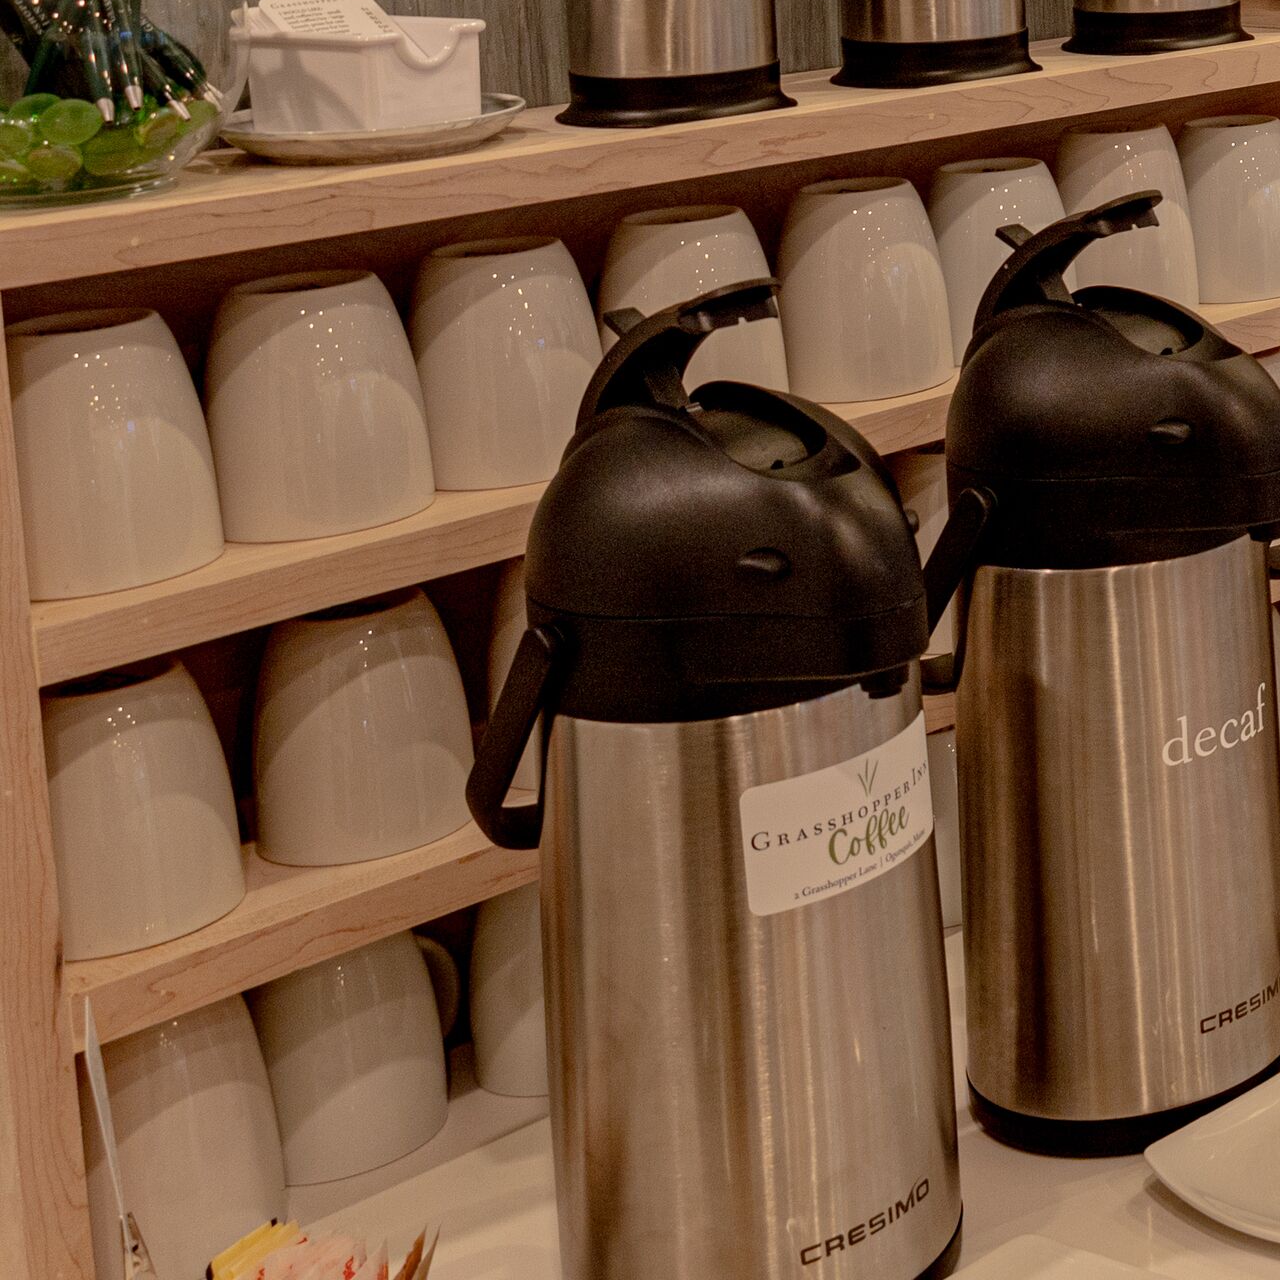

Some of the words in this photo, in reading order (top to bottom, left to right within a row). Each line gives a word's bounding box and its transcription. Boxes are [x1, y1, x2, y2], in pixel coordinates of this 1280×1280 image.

[1162, 682, 1266, 767] decaf
[750, 780, 911, 852] GRASSHOPPER
[828, 805, 910, 865] Coffee
[802, 871, 858, 898] Grasshopper
[800, 1176, 930, 1266] CRESIMO
